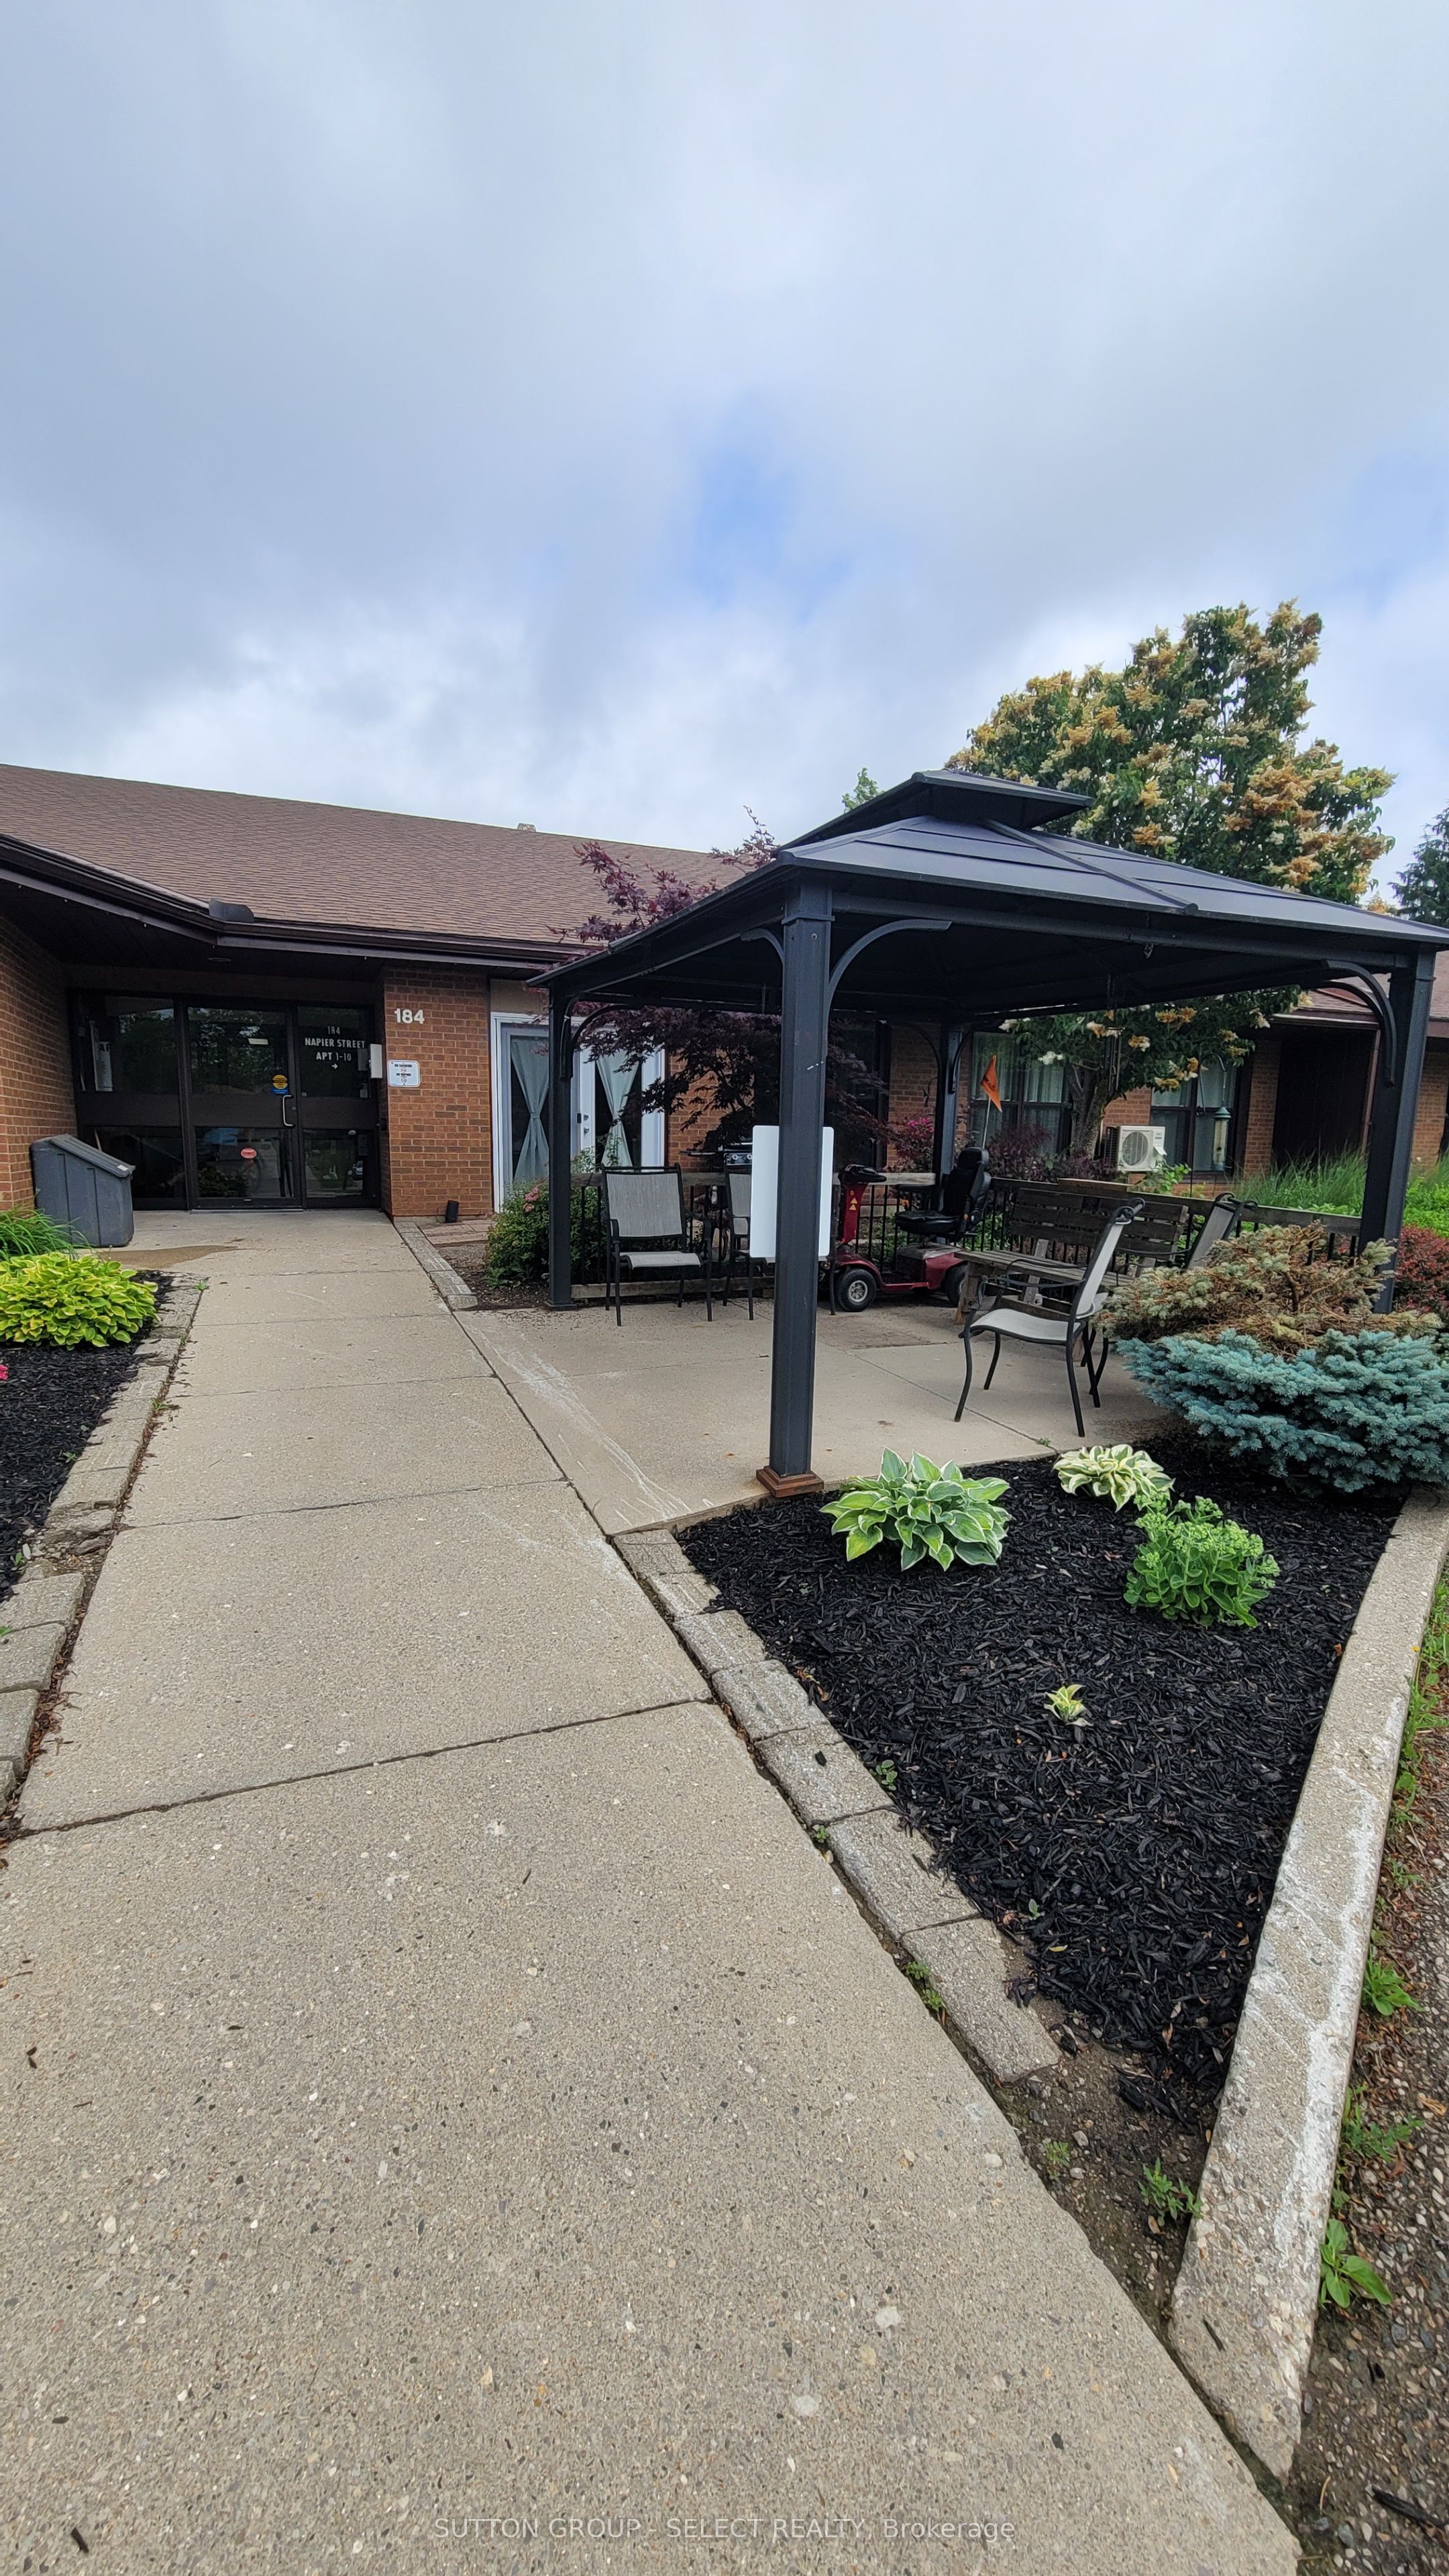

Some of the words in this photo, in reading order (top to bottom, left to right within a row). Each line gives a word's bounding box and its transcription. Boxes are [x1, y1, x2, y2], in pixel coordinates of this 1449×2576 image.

[394, 1008, 425, 1024] 184
[327, 1026, 340, 1034] 184
[305, 1037, 335, 1046] NAPIER
[337, 1039, 366, 1048] STREET
[316, 1052, 333, 1060] APT
[335, 1053, 352, 1061] 1-10
